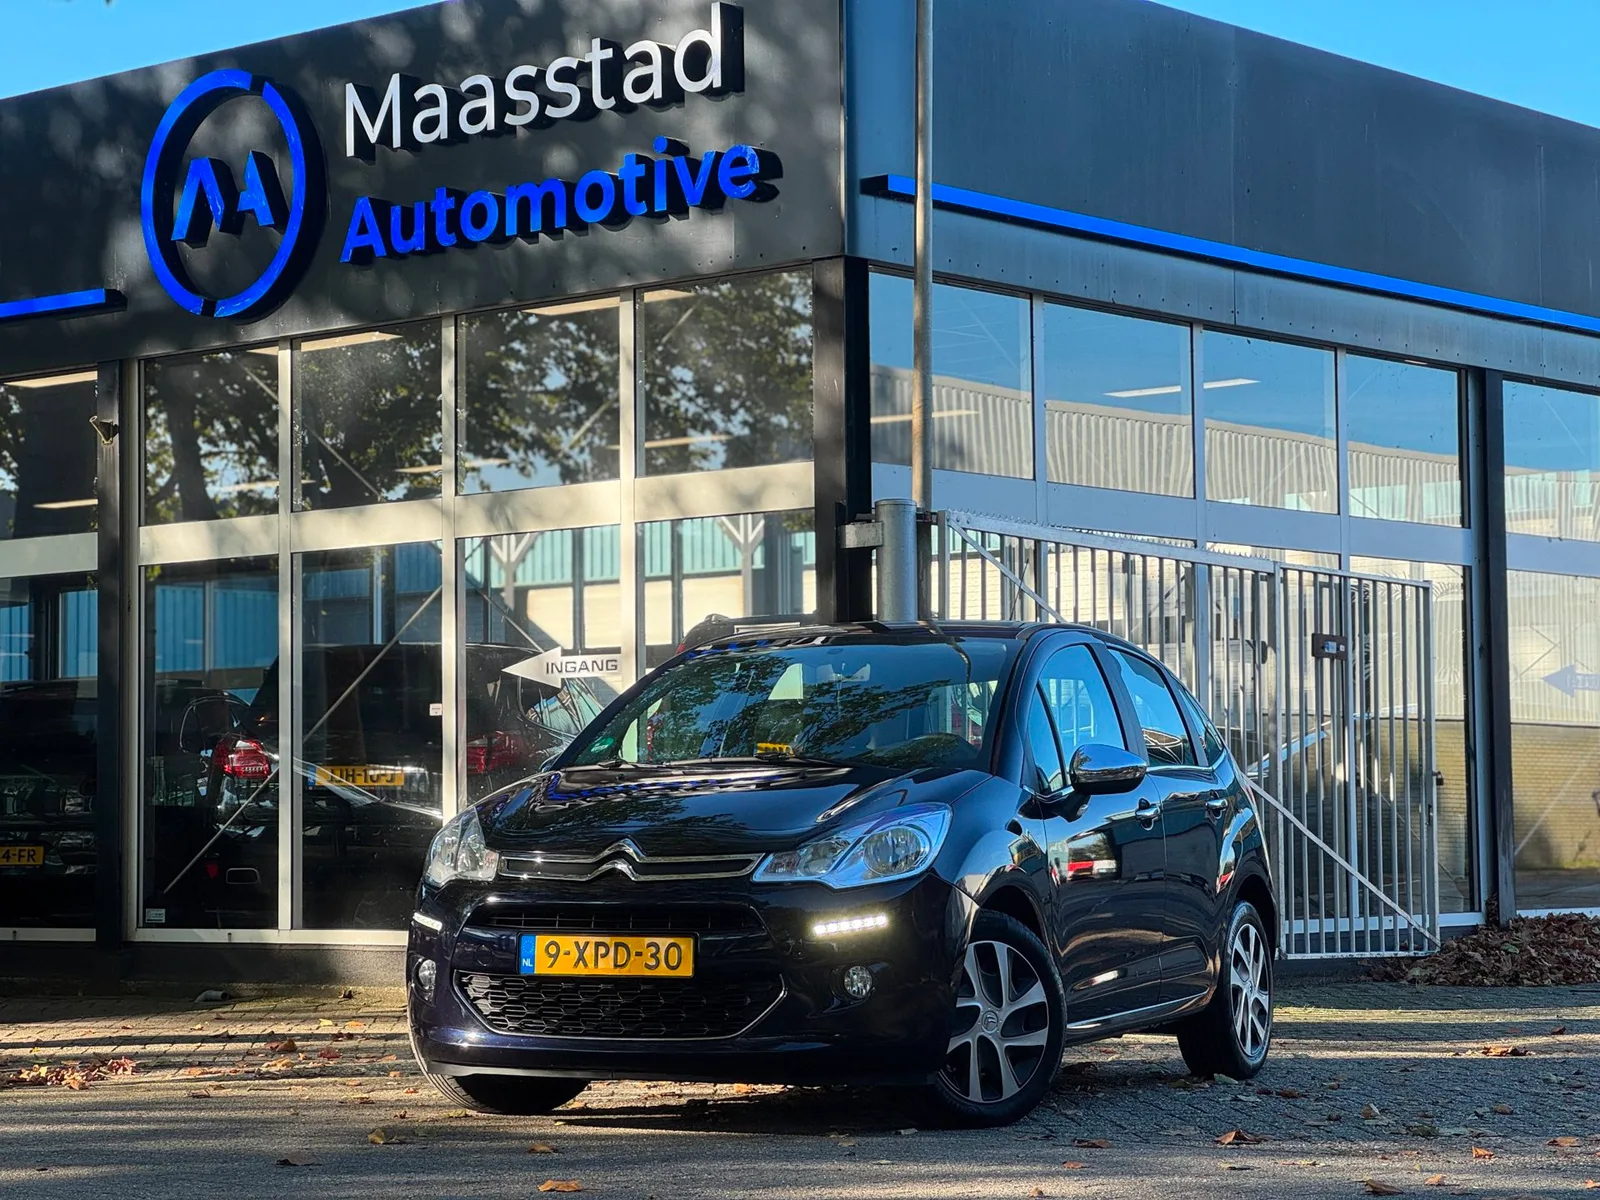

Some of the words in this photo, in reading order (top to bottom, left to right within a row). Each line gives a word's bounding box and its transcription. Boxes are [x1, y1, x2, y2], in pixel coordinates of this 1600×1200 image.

[345, 2, 723, 157] Maasstad
[340, 136, 760, 263] Automotive
[546, 659, 619, 674] INGANG
[522, 958, 534, 967] NL
[544, 940, 683, 971] 9-XPD-30
